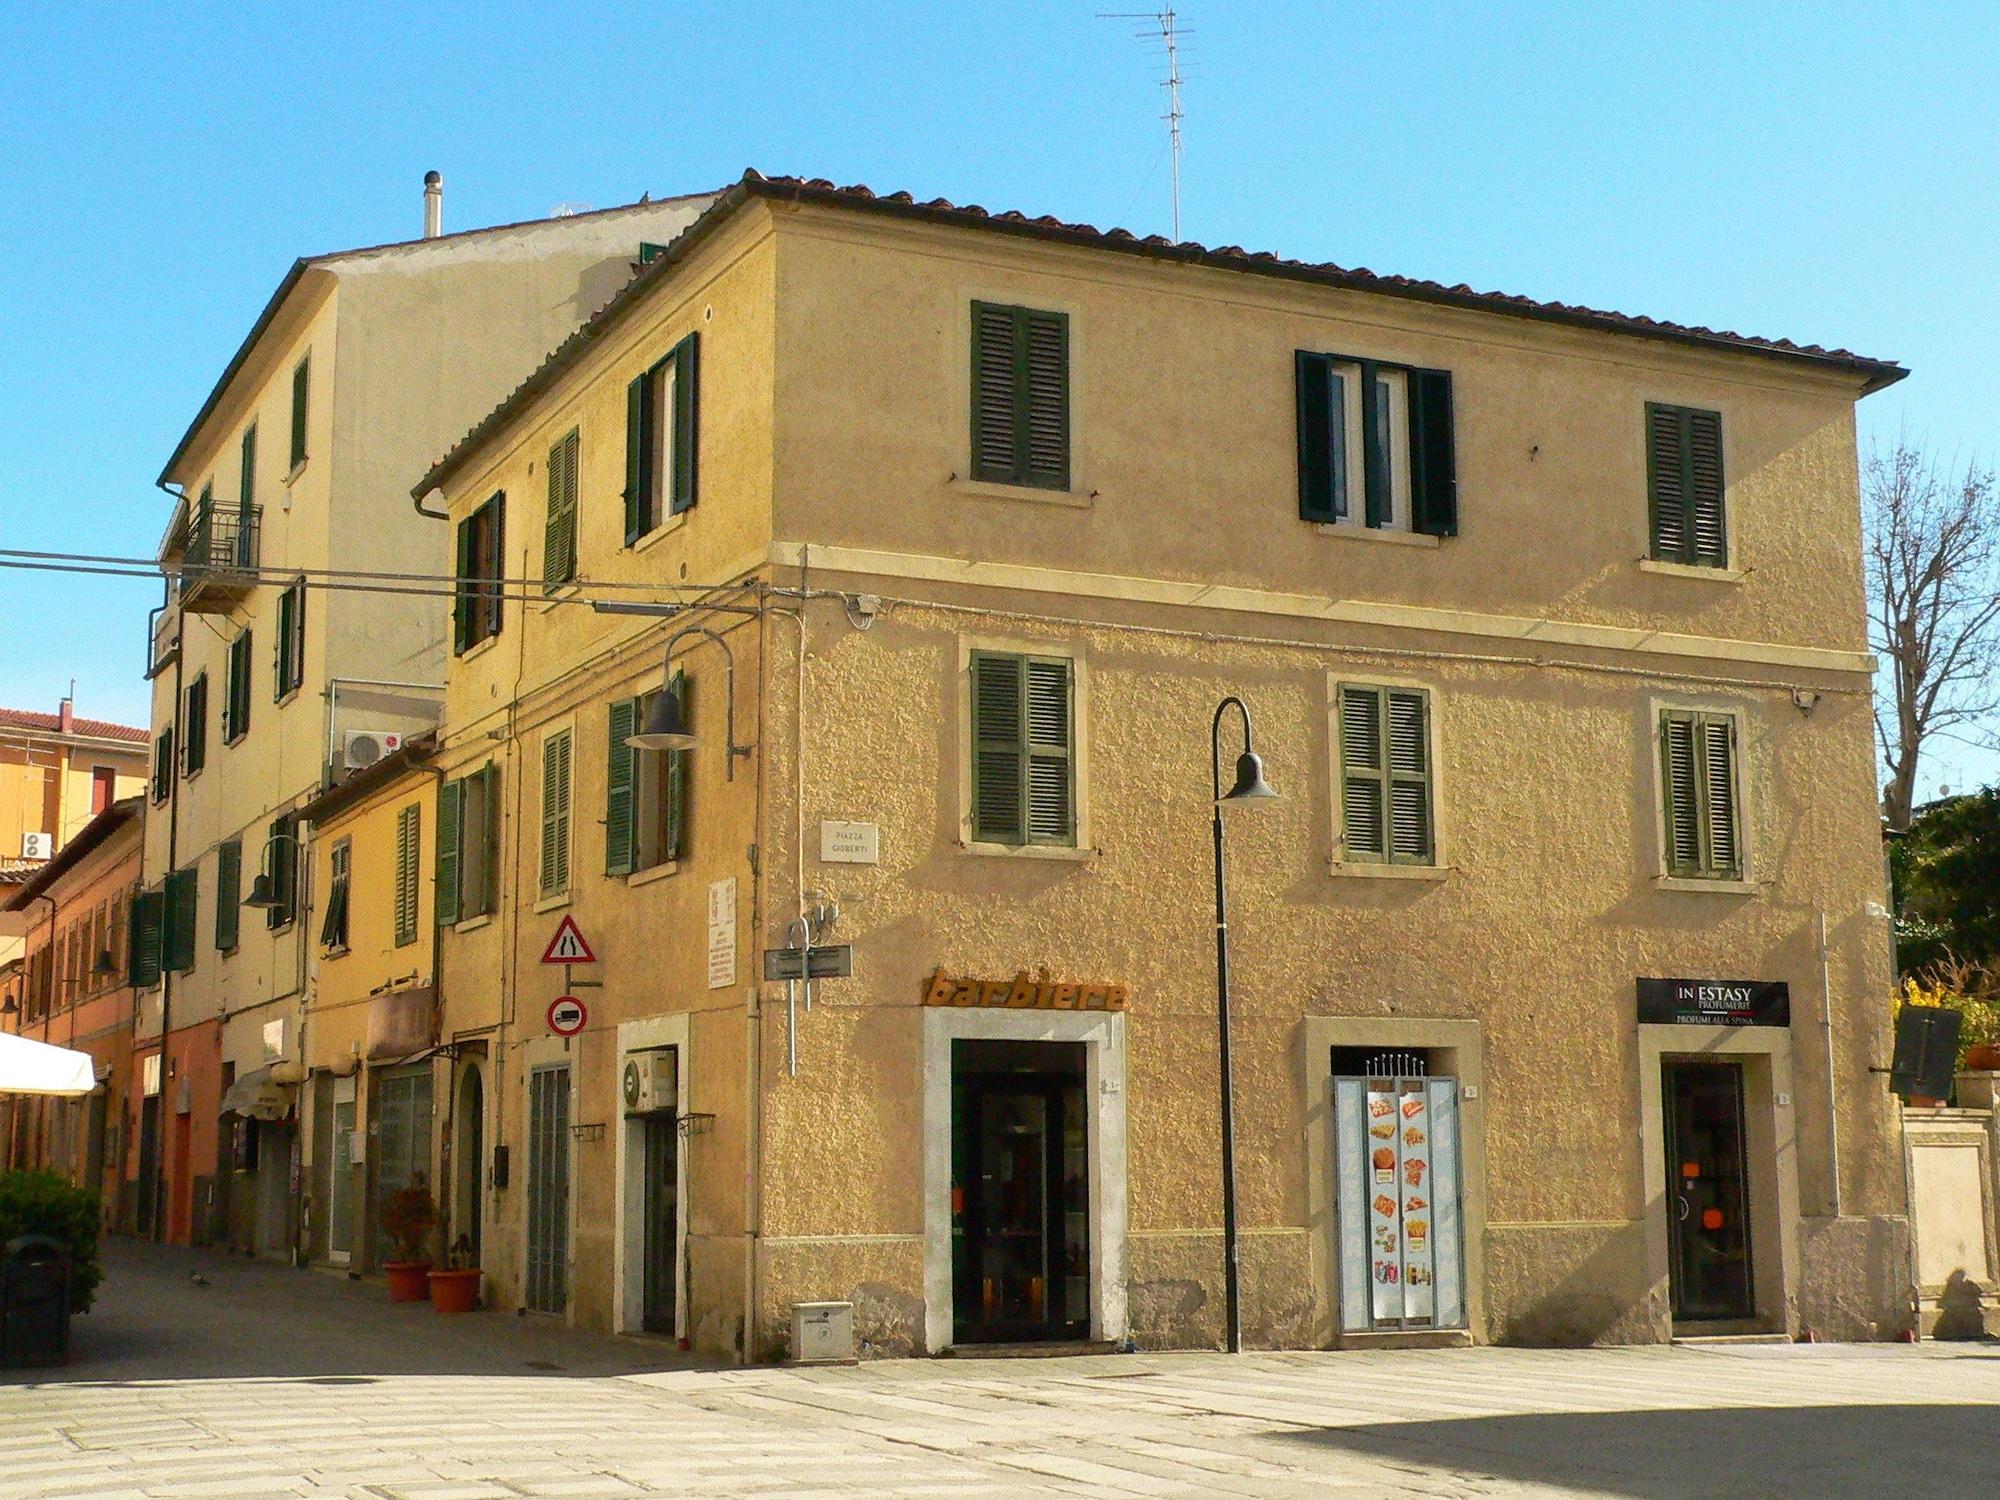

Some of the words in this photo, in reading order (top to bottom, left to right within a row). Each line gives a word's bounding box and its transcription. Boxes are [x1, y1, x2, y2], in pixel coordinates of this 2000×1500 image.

[836, 831, 863, 840] PIAZZA
[832, 844, 868, 852] GIOBERTI
[926, 966, 1127, 1009] barbiere
[1679, 987, 1694, 999] IN
[1698, 986, 1752, 1001] ESTASY
[1698, 1000, 1751, 1010] PROFUMERIE
[1676, 1015, 1711, 1024] PROFUMI
